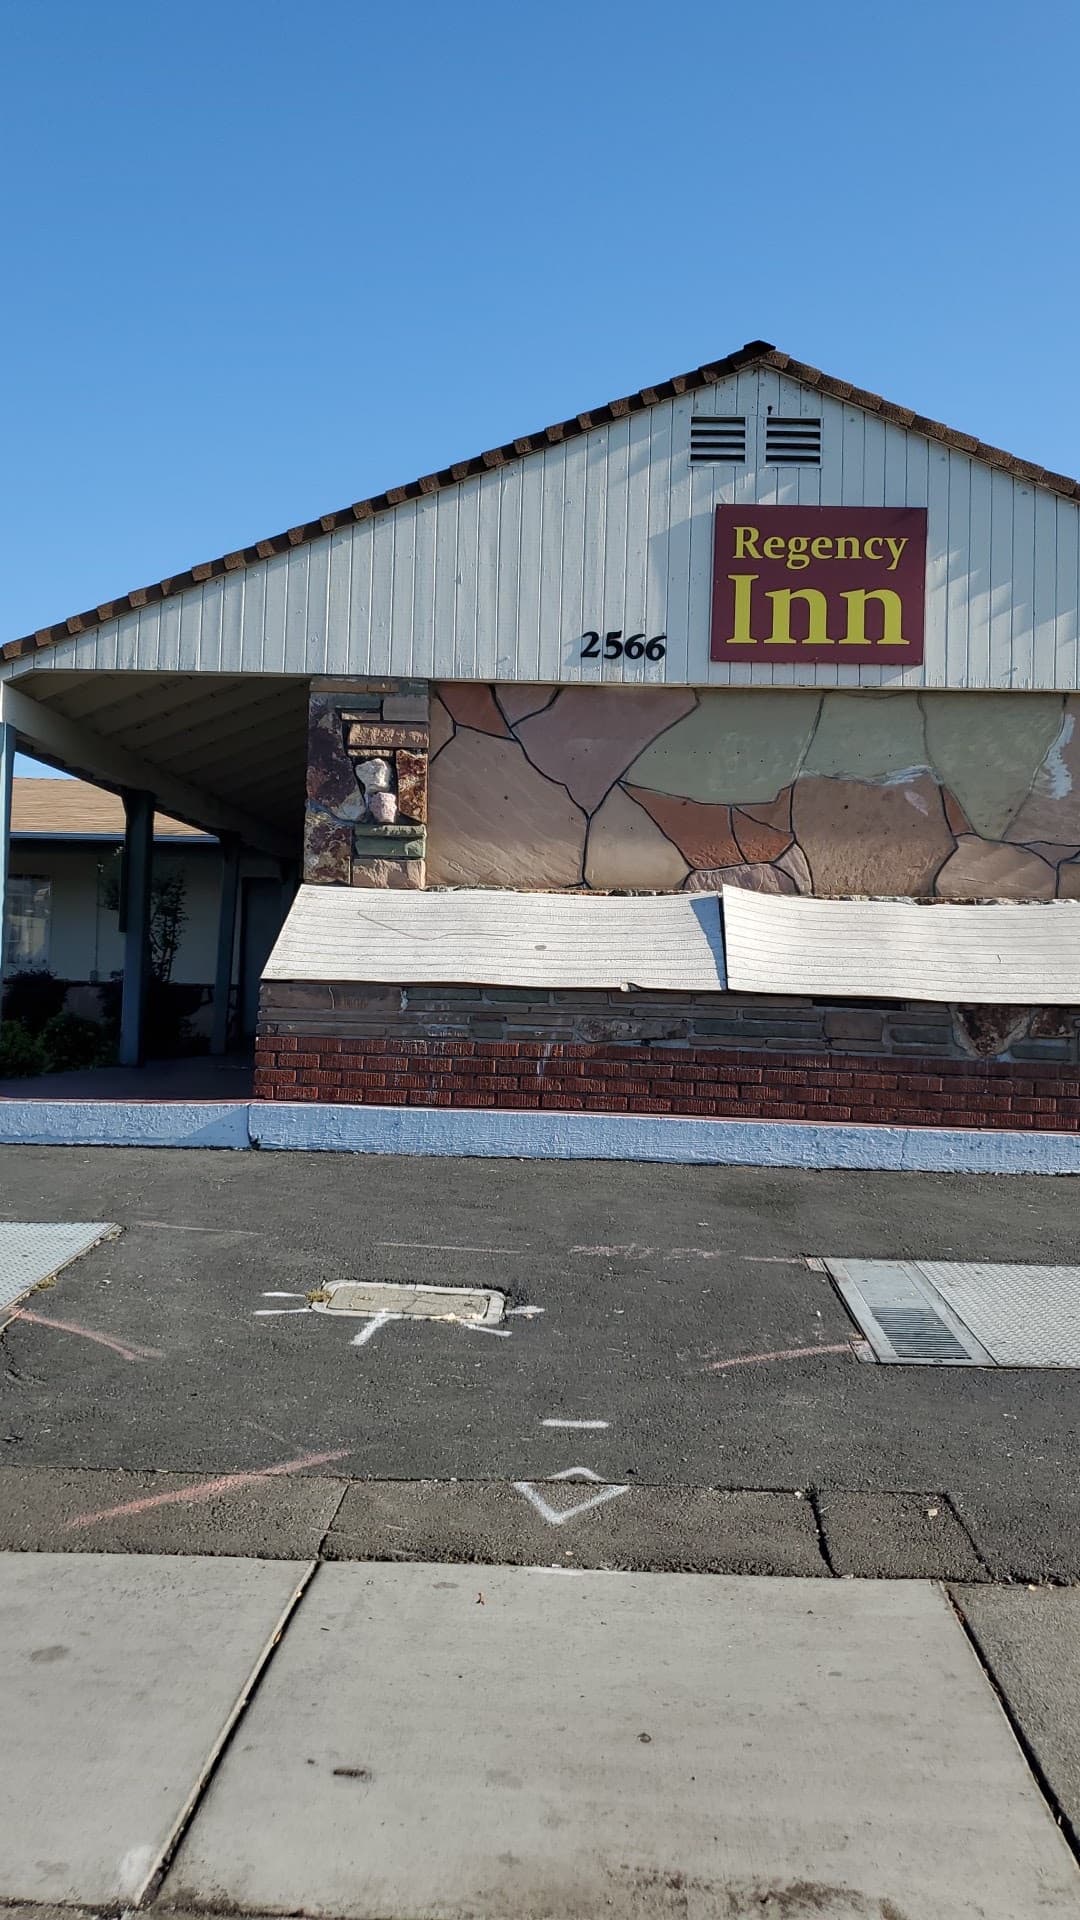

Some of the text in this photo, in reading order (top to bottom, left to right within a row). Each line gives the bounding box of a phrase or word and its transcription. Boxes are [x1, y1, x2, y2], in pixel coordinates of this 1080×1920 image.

[732, 526, 909, 570] Regency
[726, 574, 910, 645] Inn
[580, 631, 667, 661] 2566
